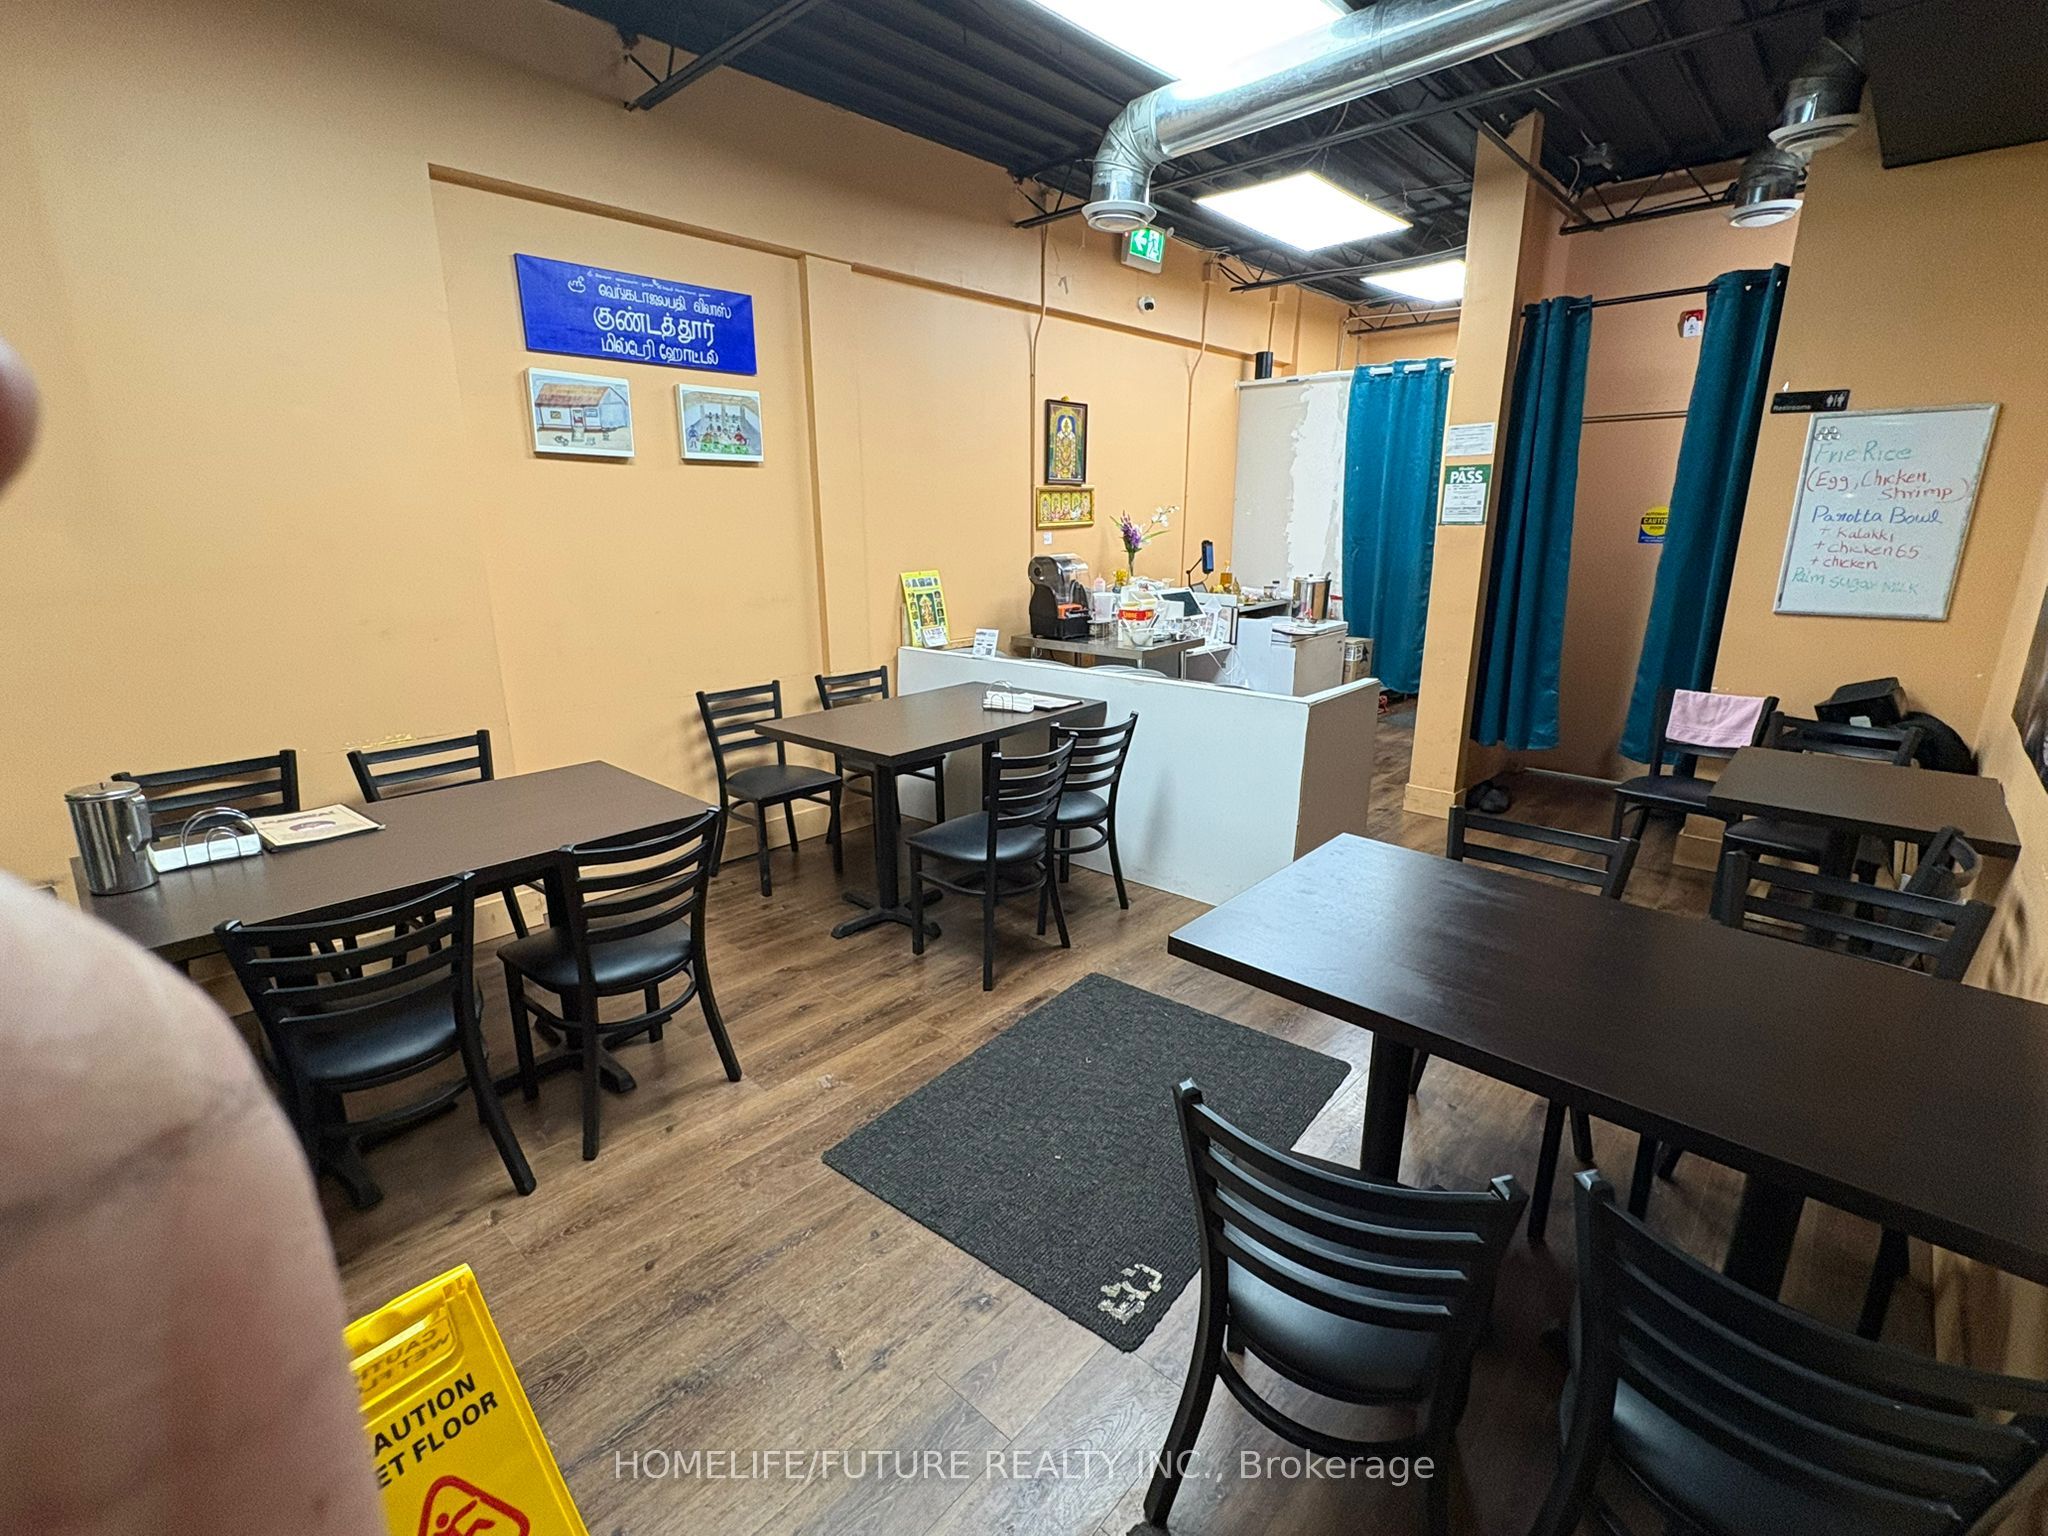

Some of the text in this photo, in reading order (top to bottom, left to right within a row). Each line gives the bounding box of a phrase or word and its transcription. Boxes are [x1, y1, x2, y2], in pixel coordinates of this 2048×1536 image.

[593, 306, 715, 347] குண்டத்தூர்
[1863, 440, 1912, 462] Rice
[1450, 470, 1483, 484] PASS
[1643, 517, 1668, 525] CAUTIO
[374, 1372, 476, 1458] AUTION
[375, 1391, 499, 1490] ET FLOOR
